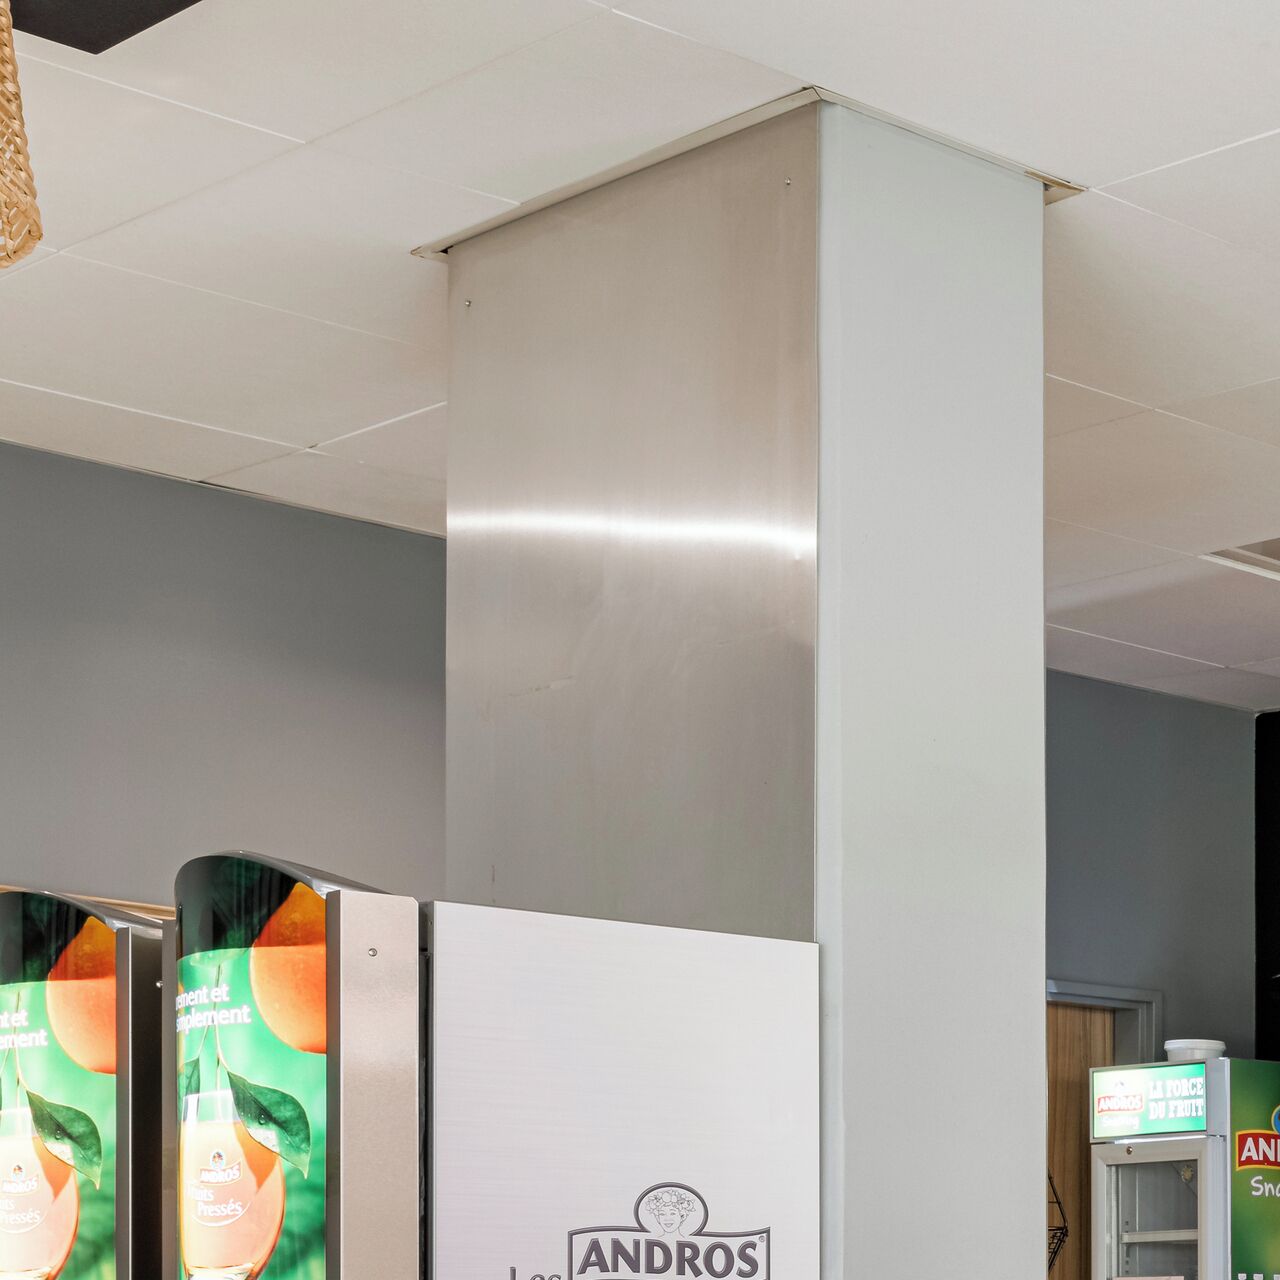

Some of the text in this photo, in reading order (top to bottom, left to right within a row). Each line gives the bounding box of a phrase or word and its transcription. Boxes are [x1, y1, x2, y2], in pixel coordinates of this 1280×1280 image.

[210, 983, 230, 1002] et
[1150, 1078, 1204, 1098] LA FORCE
[1149, 1098, 1204, 1119] DU FRUIT
[576, 1237, 760, 1279] ANDROS
